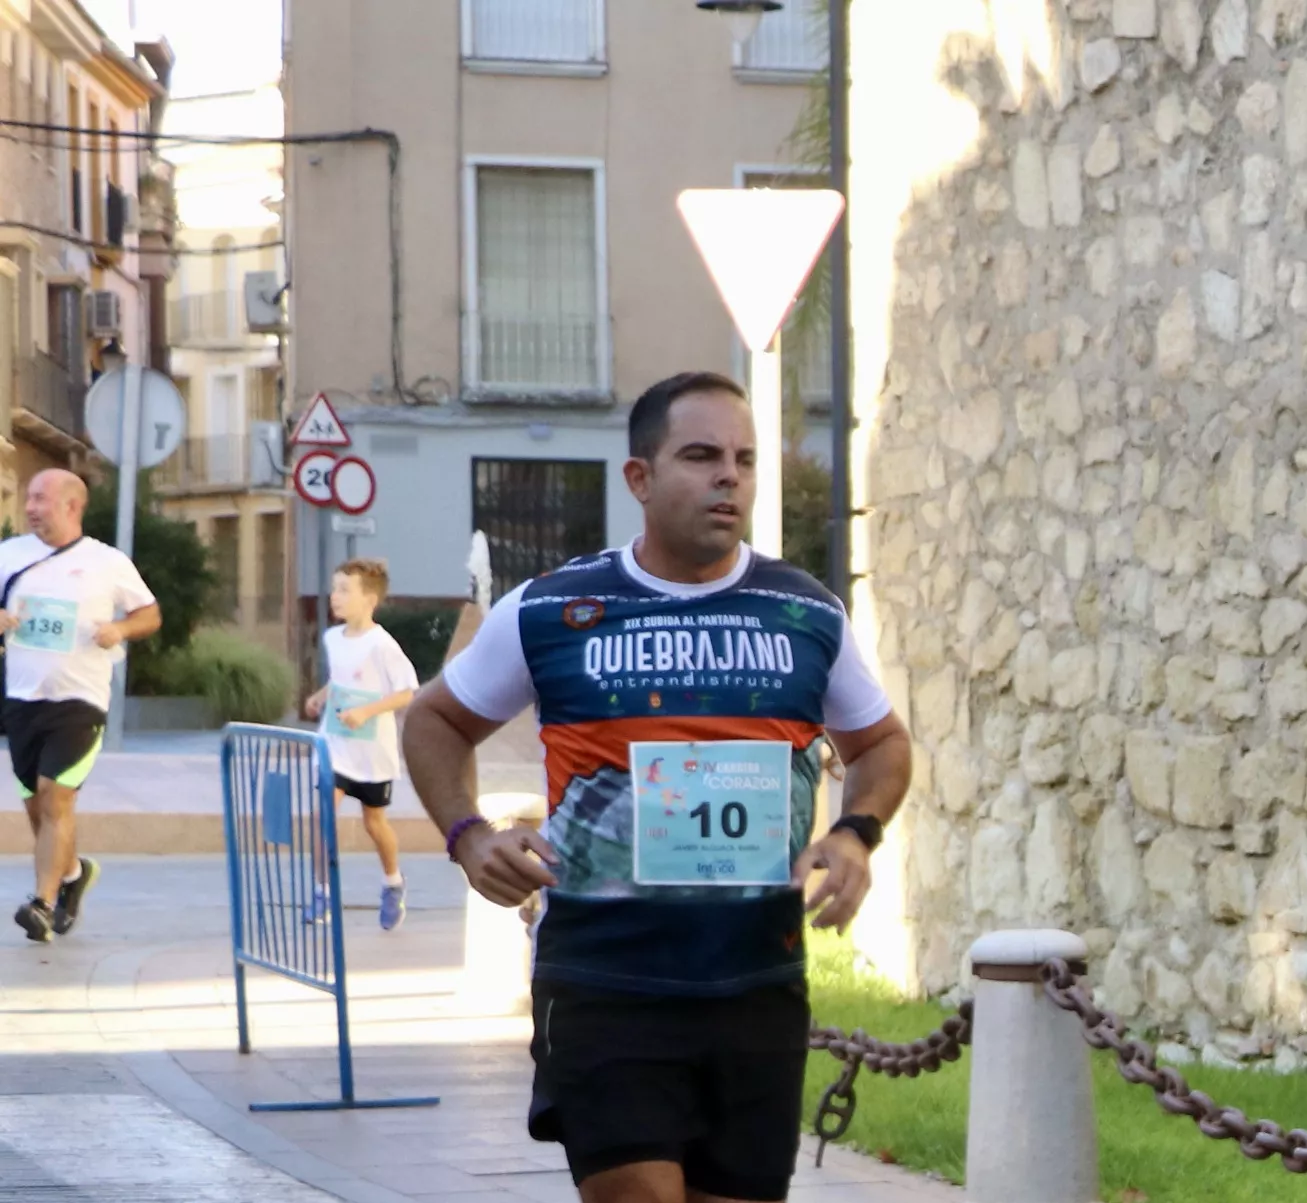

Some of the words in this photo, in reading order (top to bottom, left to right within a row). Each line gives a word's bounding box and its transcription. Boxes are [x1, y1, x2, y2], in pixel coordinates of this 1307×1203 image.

[27, 618, 64, 635] 138
[624, 618, 642, 630] XIX
[643, 615, 681, 628] SUBIDA
[682, 615, 696, 627] AL
[698, 614, 742, 627] PANTANO
[744, 616, 763, 629] DEL
[584, 629, 794, 681] QUIEBRAJANO
[690, 801, 748, 838] 10
